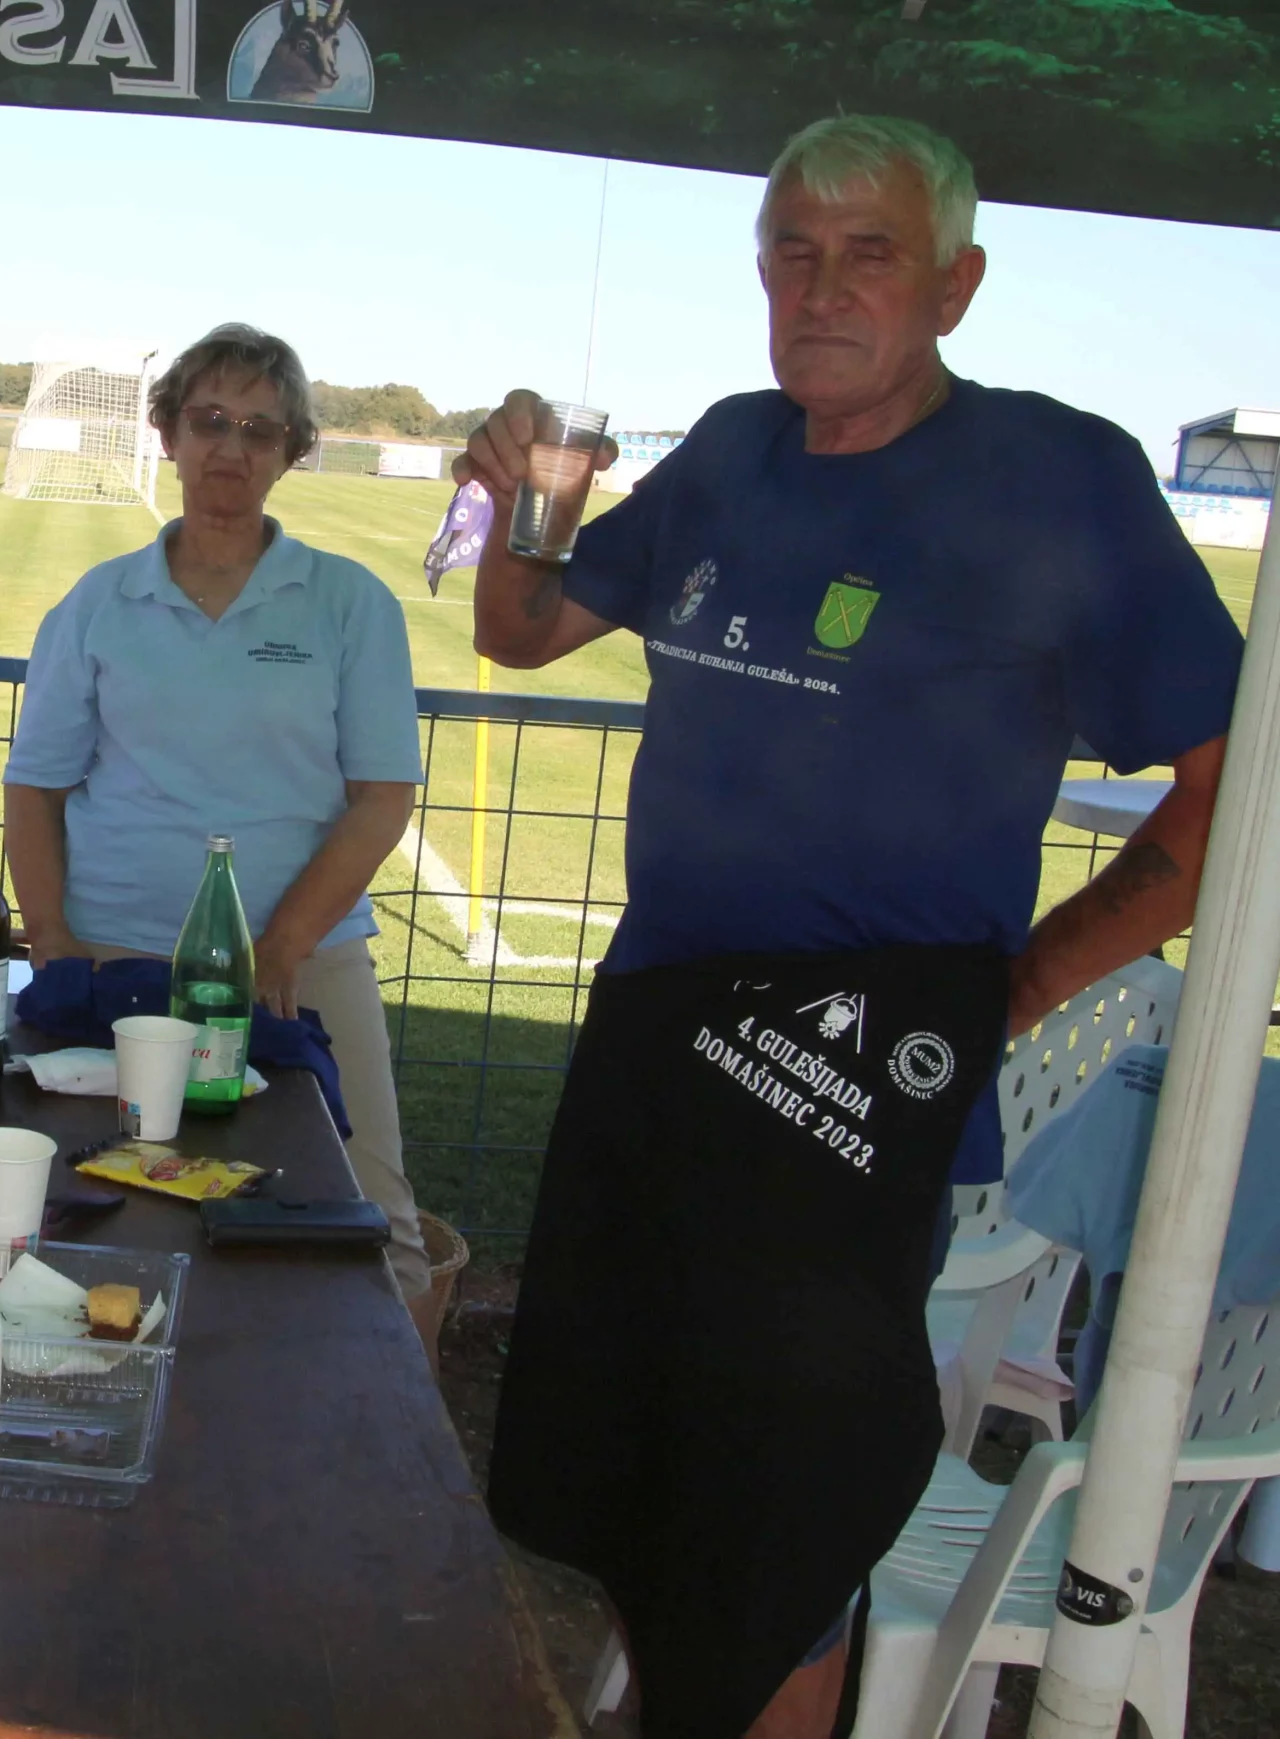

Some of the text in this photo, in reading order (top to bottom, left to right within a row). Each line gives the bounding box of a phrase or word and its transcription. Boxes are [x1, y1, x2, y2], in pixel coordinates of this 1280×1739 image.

[723, 615, 751, 652] 5.
[698, 653, 746, 674] KUHANJA
[803, 677, 842, 696] 2024.
[737, 1015, 873, 1121] 4. GULEŠIJADA
[887, 1059, 934, 1100] DOMAŠINEC
[692, 1025, 875, 1175] DOMAŠINEC 2023.
[1077, 1586, 1106, 1607] VIS
